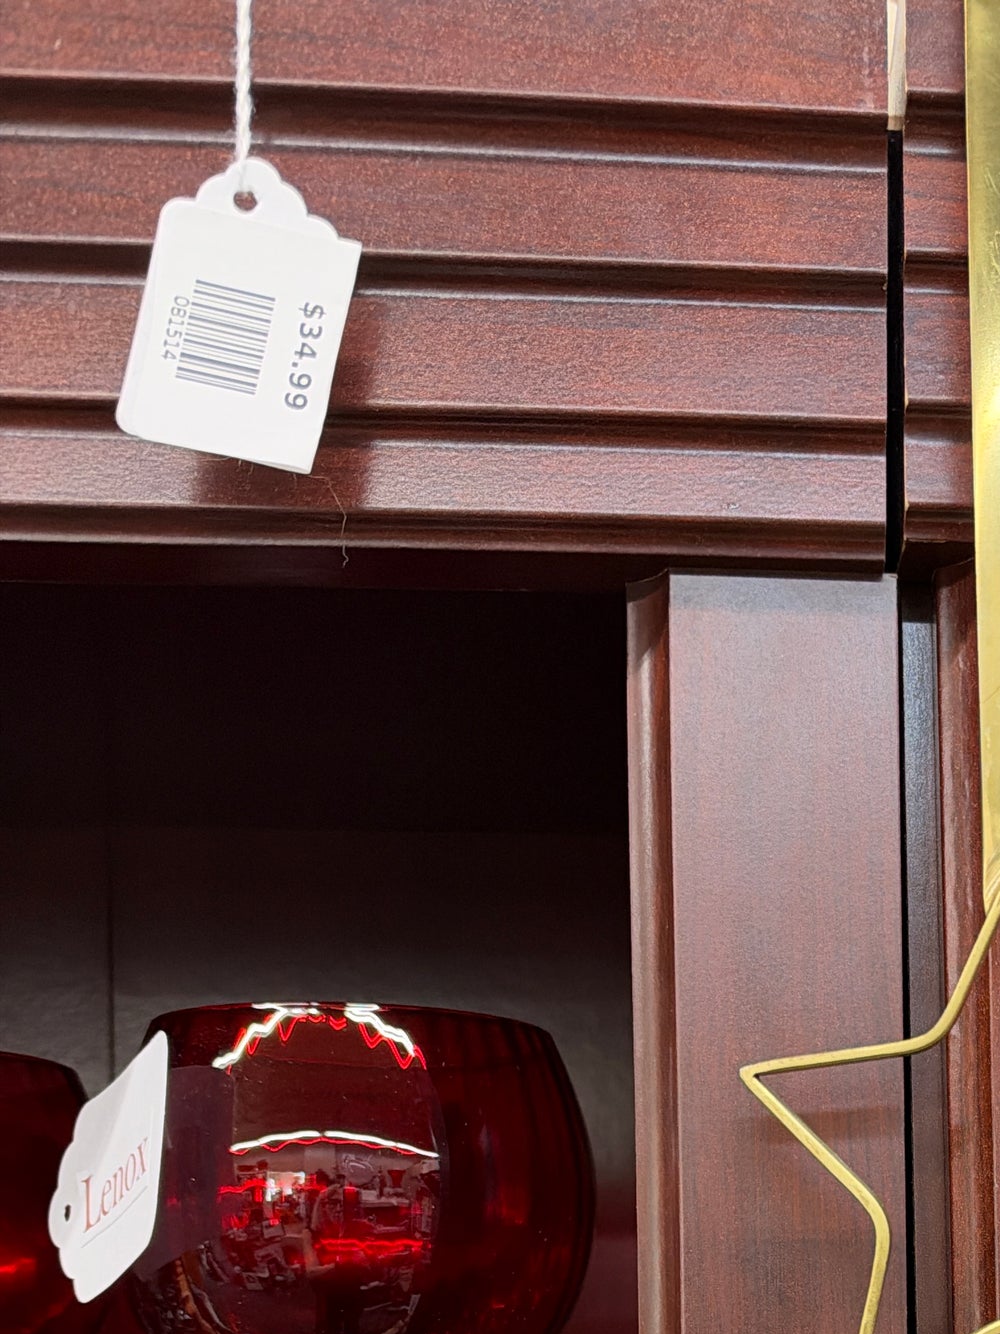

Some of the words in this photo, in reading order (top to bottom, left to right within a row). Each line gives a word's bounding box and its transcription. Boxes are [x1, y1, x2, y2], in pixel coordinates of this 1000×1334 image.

[161, 294, 190, 362] 081514
[284, 301, 326, 411] $34.99
[81, 1137, 148, 1234] Lenox
